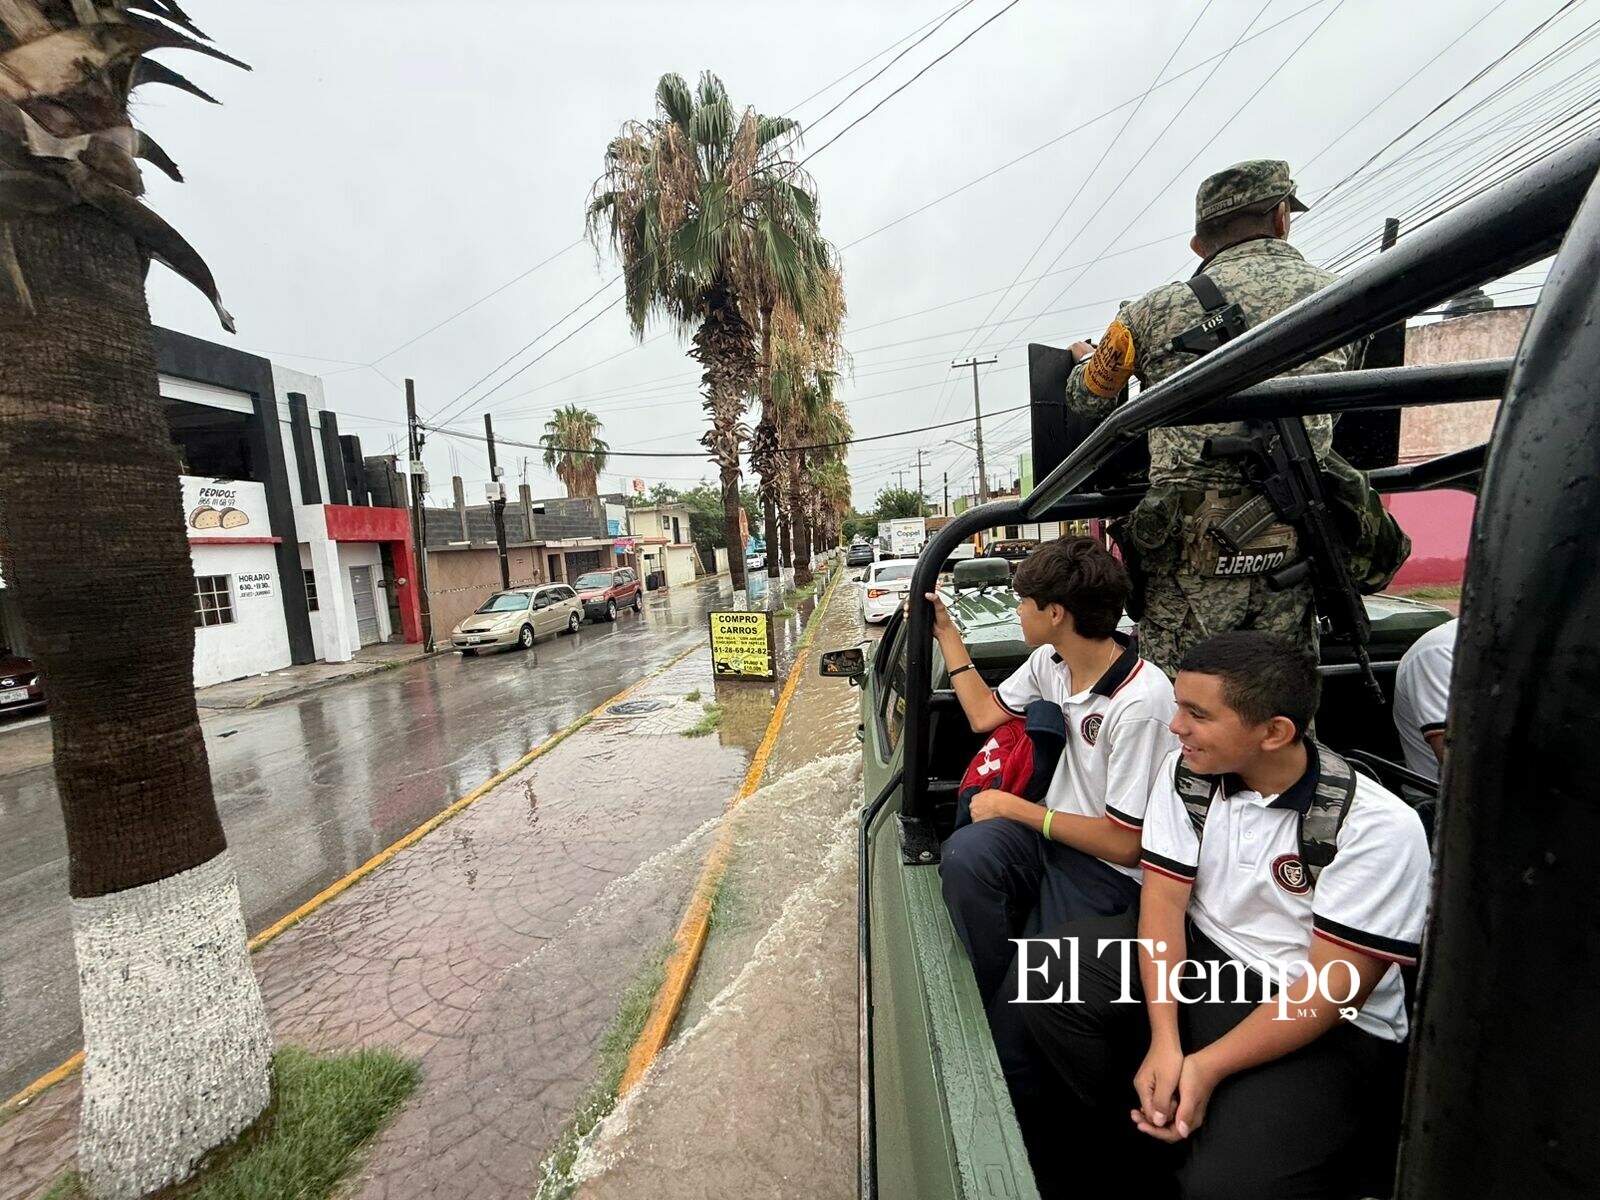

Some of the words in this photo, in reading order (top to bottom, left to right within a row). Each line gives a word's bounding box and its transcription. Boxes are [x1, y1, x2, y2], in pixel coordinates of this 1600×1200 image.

[199, 487, 237, 499] PEDIDOS
[896, 530, 921, 538] Coppel
[1214, 551, 1285, 575] EJÉRCITO
[238, 573, 271, 583] HORARIO
[718, 615, 758, 623] COMPRO
[720, 626, 758, 634] CARROS
